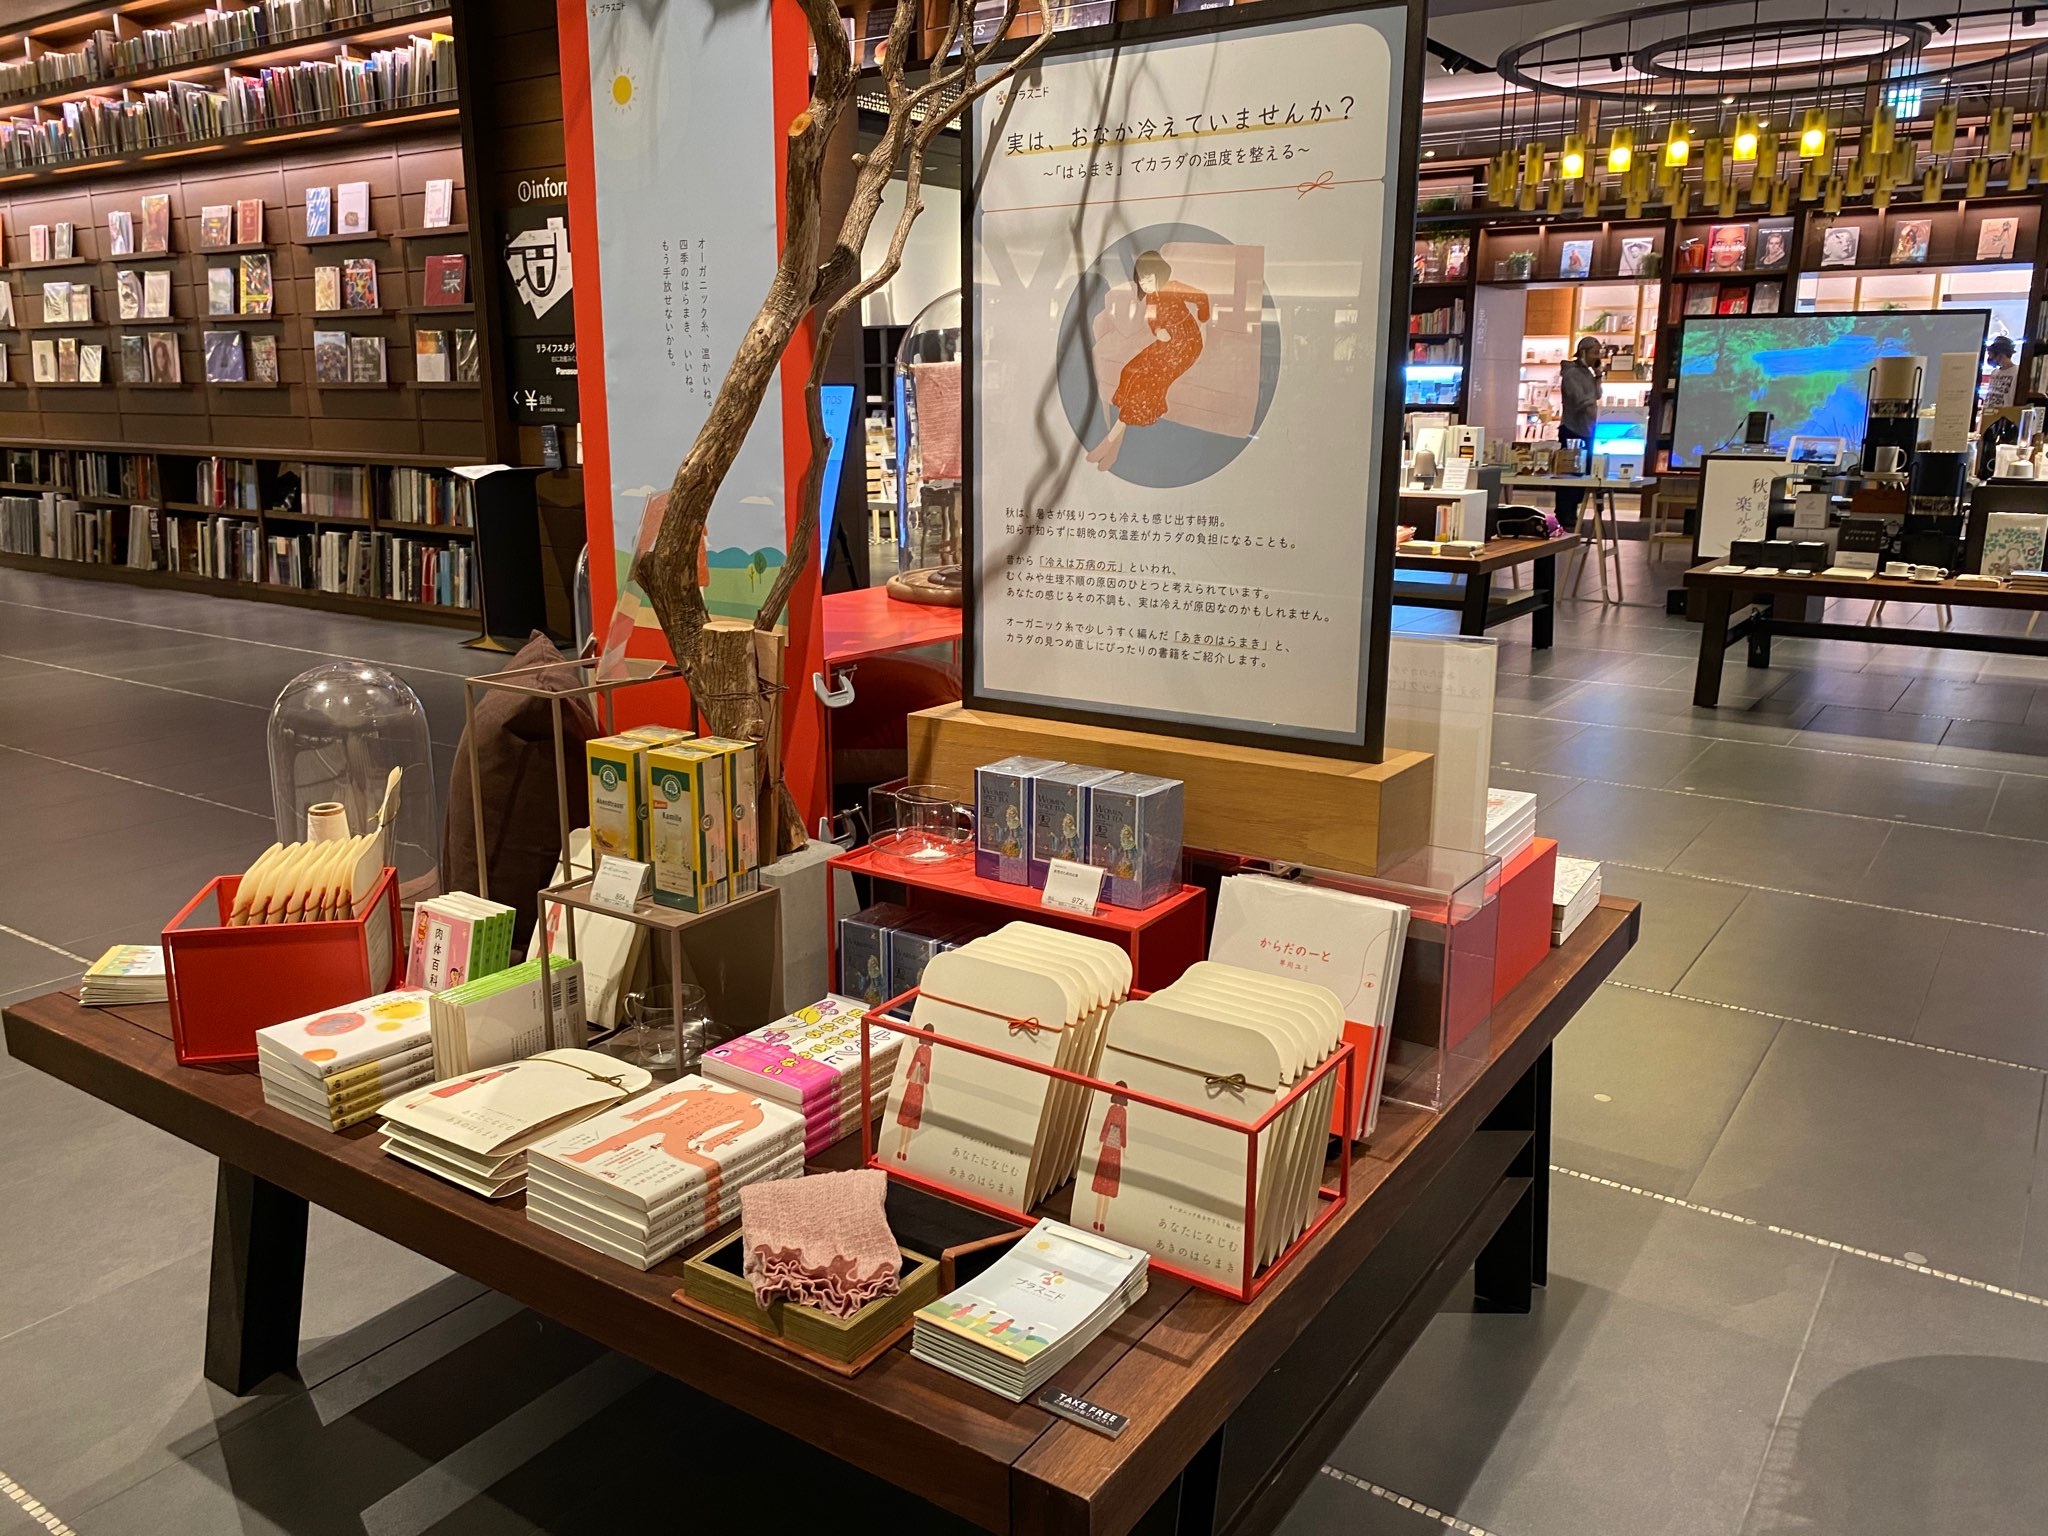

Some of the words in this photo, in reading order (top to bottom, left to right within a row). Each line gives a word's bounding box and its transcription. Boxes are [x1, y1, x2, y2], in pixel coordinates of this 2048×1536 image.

[1006, 95, 1355, 156] 実は、おなか冷えていませんか？
[662, 240, 676, 367] もう手放せないかも。
[536, 342, 576, 354] リライフスタジ
[1071, 896, 1085, 906] 972
[429, 928, 444, 987] 肉体百科
[1260, 937, 1331, 963] からだのーと
[952, 1147, 1019, 1177] あなたになじむ
[949, 1166, 1015, 1197] あきのはらまき
[1158, 1218, 1238, 1252] あなたになじむ
[1155, 1239, 1235, 1274] あきのはらまき
[1058, 1393, 1089, 1410] TAKE
[1088, 1406, 1119, 1423] FREE
